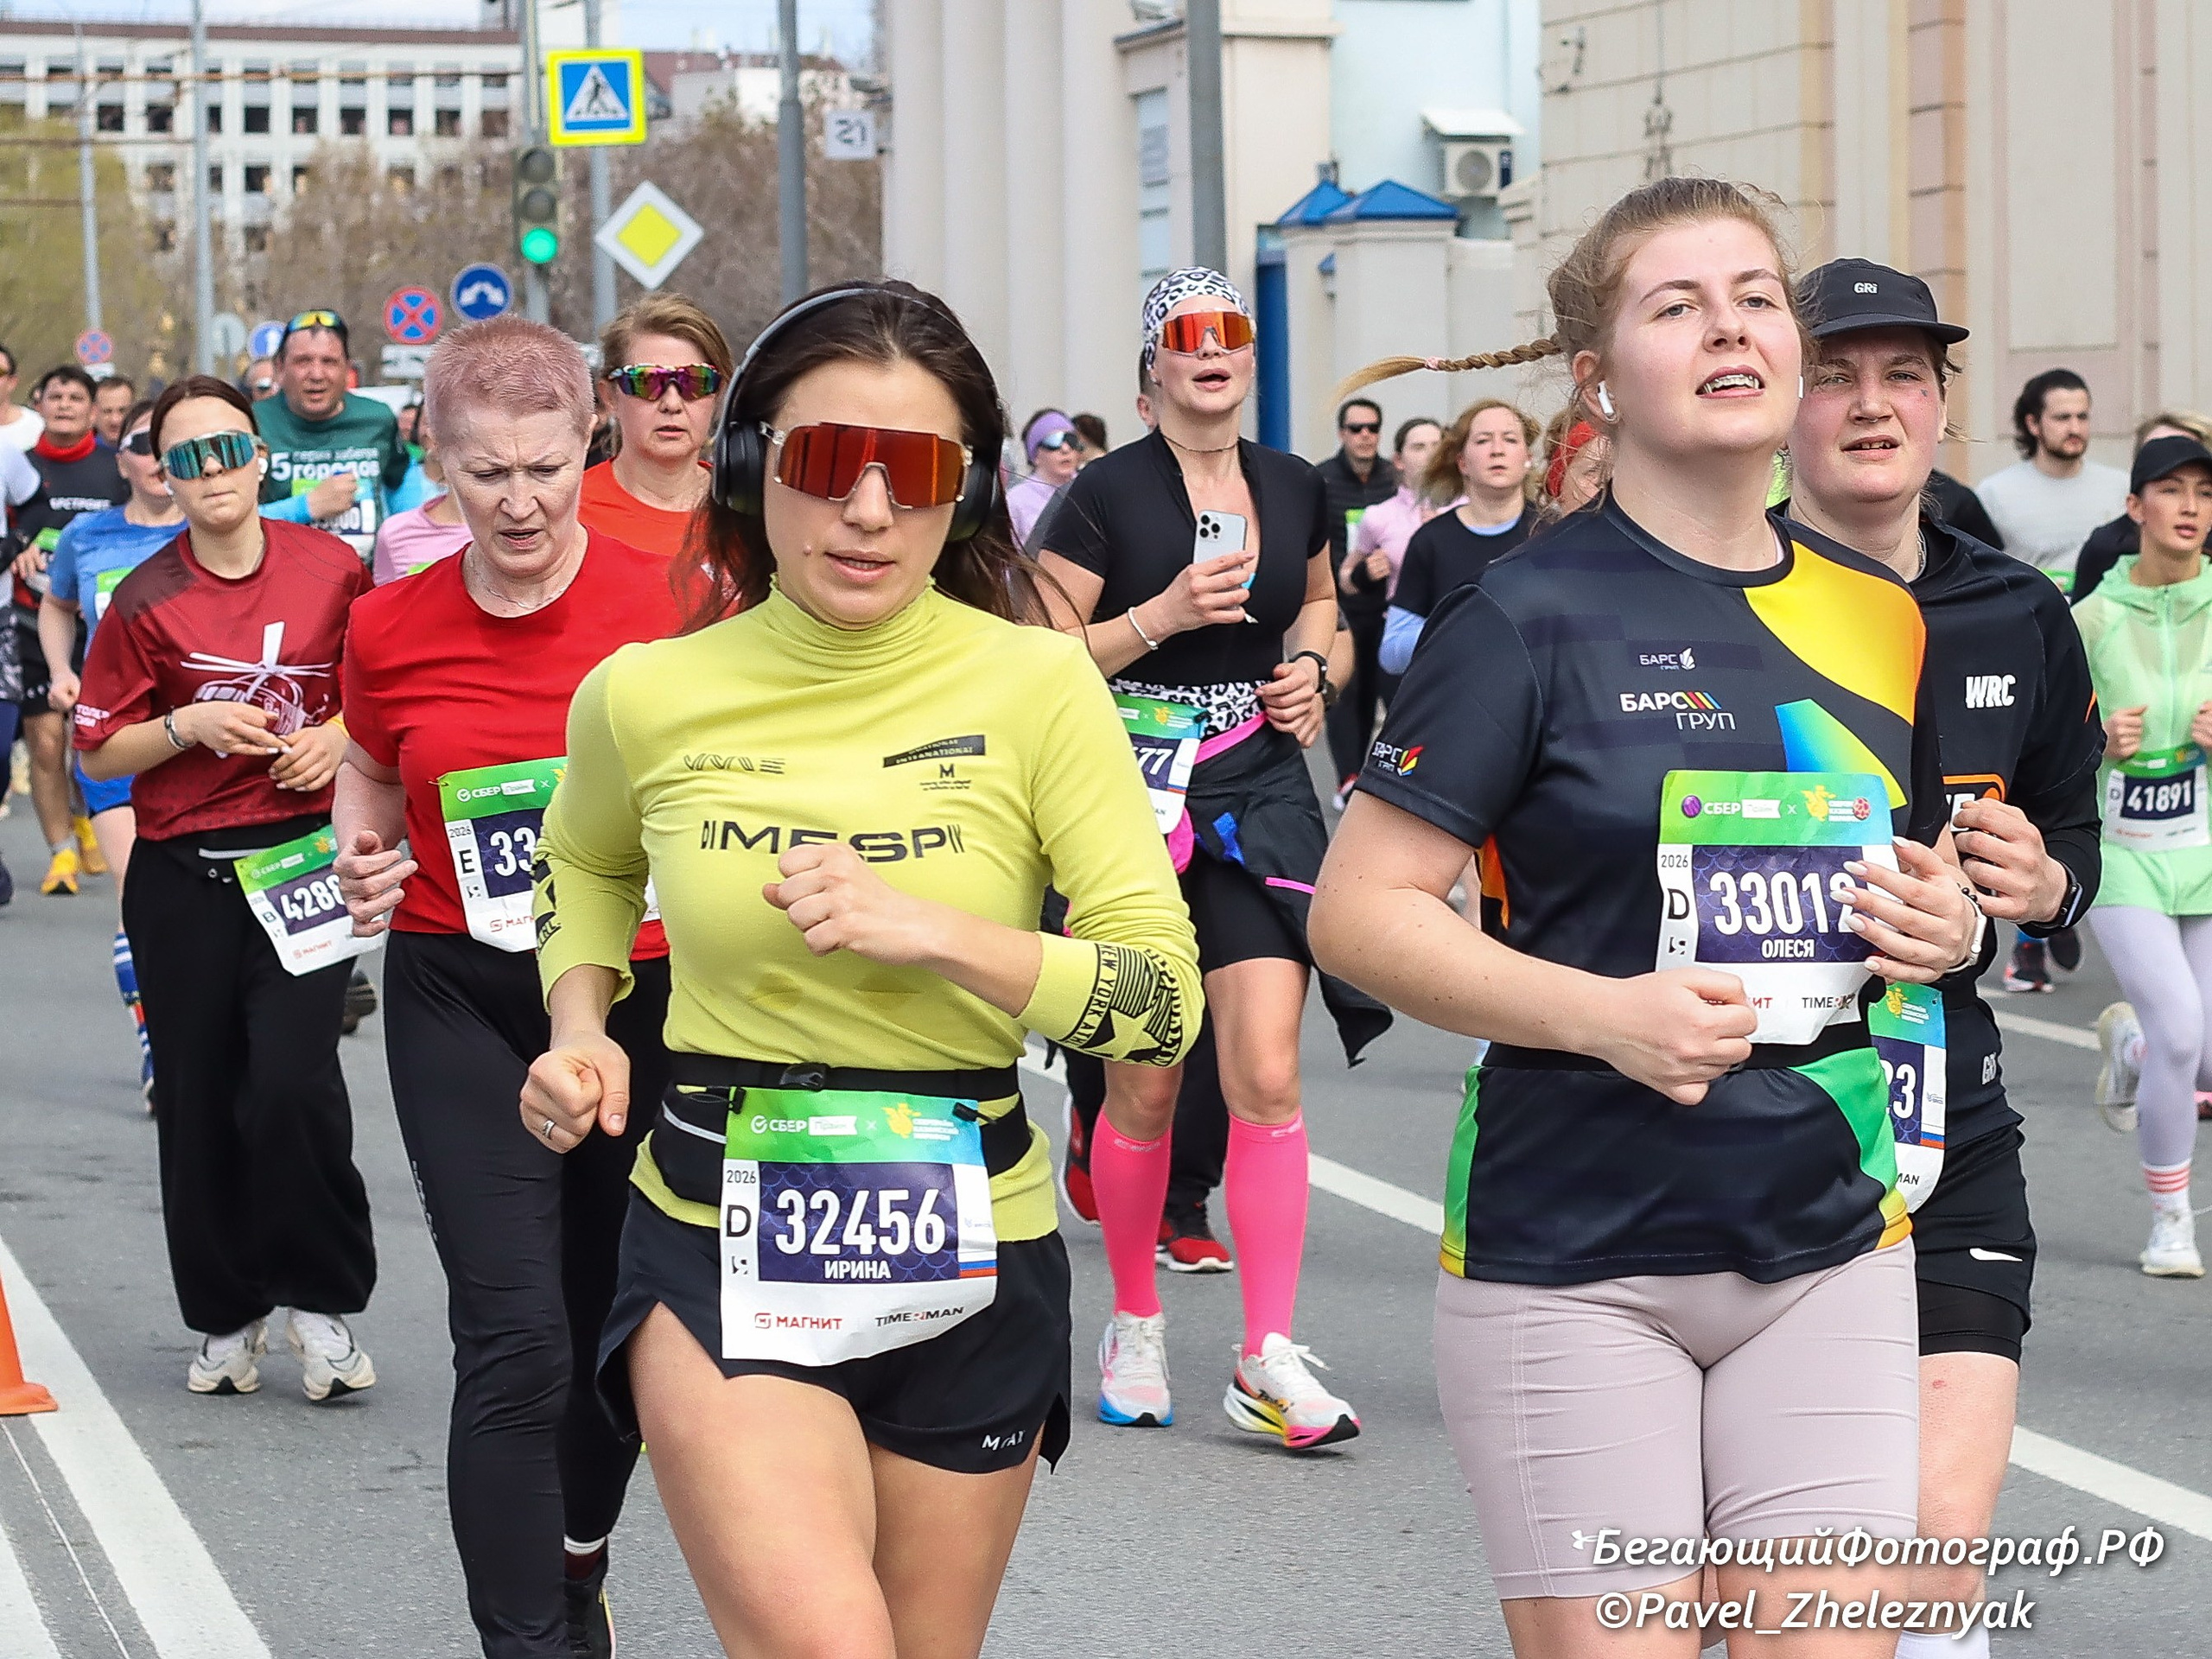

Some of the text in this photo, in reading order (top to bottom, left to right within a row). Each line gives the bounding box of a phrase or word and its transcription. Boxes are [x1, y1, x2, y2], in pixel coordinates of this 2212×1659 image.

[1639, 654, 1678, 665] БАРС
[1966, 675, 2016, 709] WRC
[1619, 692, 1688, 712] БАРС
[1675, 712, 1736, 730] ГРУП
[2126, 779, 2192, 811] 41891
[1704, 802, 1741, 815] СБЕР
[448, 826, 473, 838] 2026
[458, 849, 475, 874] E
[1661, 855, 1688, 868] 2026
[1667, 888, 1690, 919] D
[1762, 939, 1815, 958] ОЛЕСЯ
[1086, 978, 1116, 1018] YORK
[769, 1119, 807, 1133] СБЕР
[727, 1170, 756, 1184] 2026
[726, 1205, 752, 1238] D
[775, 1189, 946, 1255] 32456
[823, 1260, 892, 1280] ИРИНА
[776, 1315, 842, 1330] МАГНИТ
